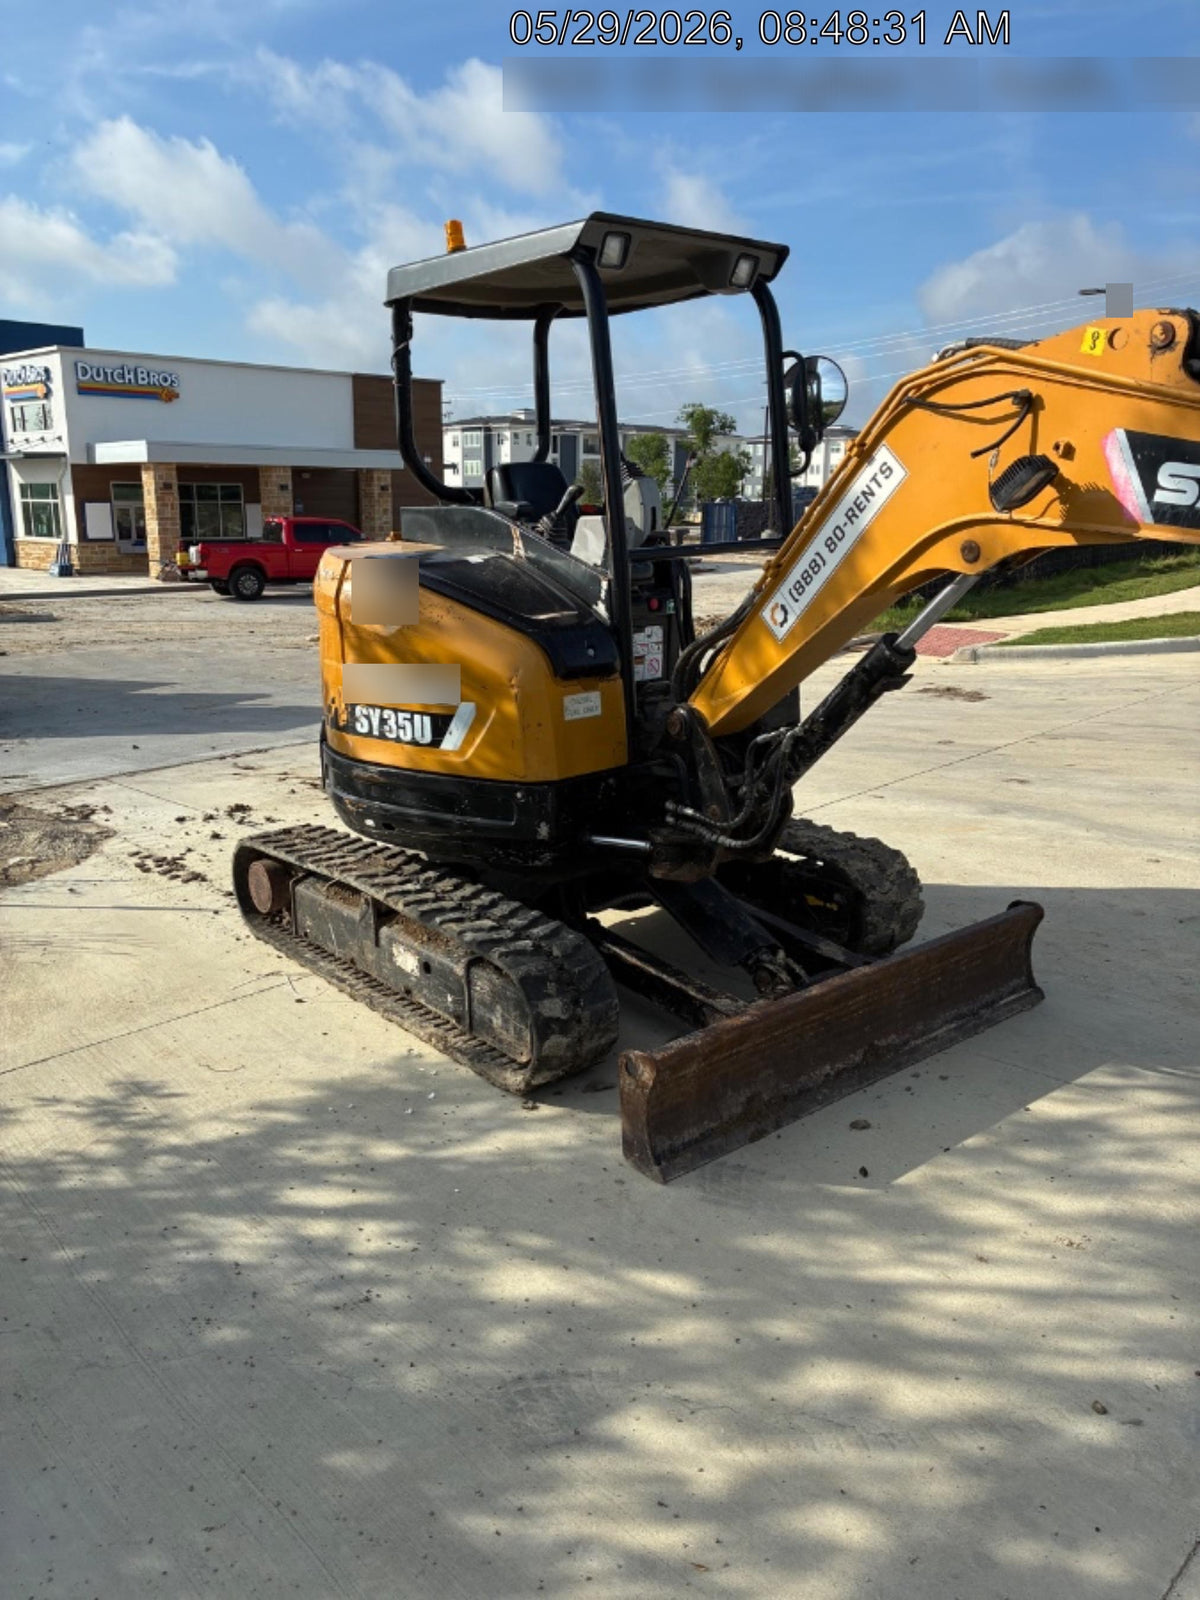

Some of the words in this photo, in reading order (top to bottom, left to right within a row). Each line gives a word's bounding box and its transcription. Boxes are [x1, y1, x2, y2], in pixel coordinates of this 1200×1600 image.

[76, 361, 135, 385] DUTCH
[136, 366, 180, 388] BROS
[1153, 461, 1200, 508] S
[787, 551, 827, 603] (888)
[824, 461, 894, 554] 80-RENTS
[354, 703, 433, 745] SY35U
